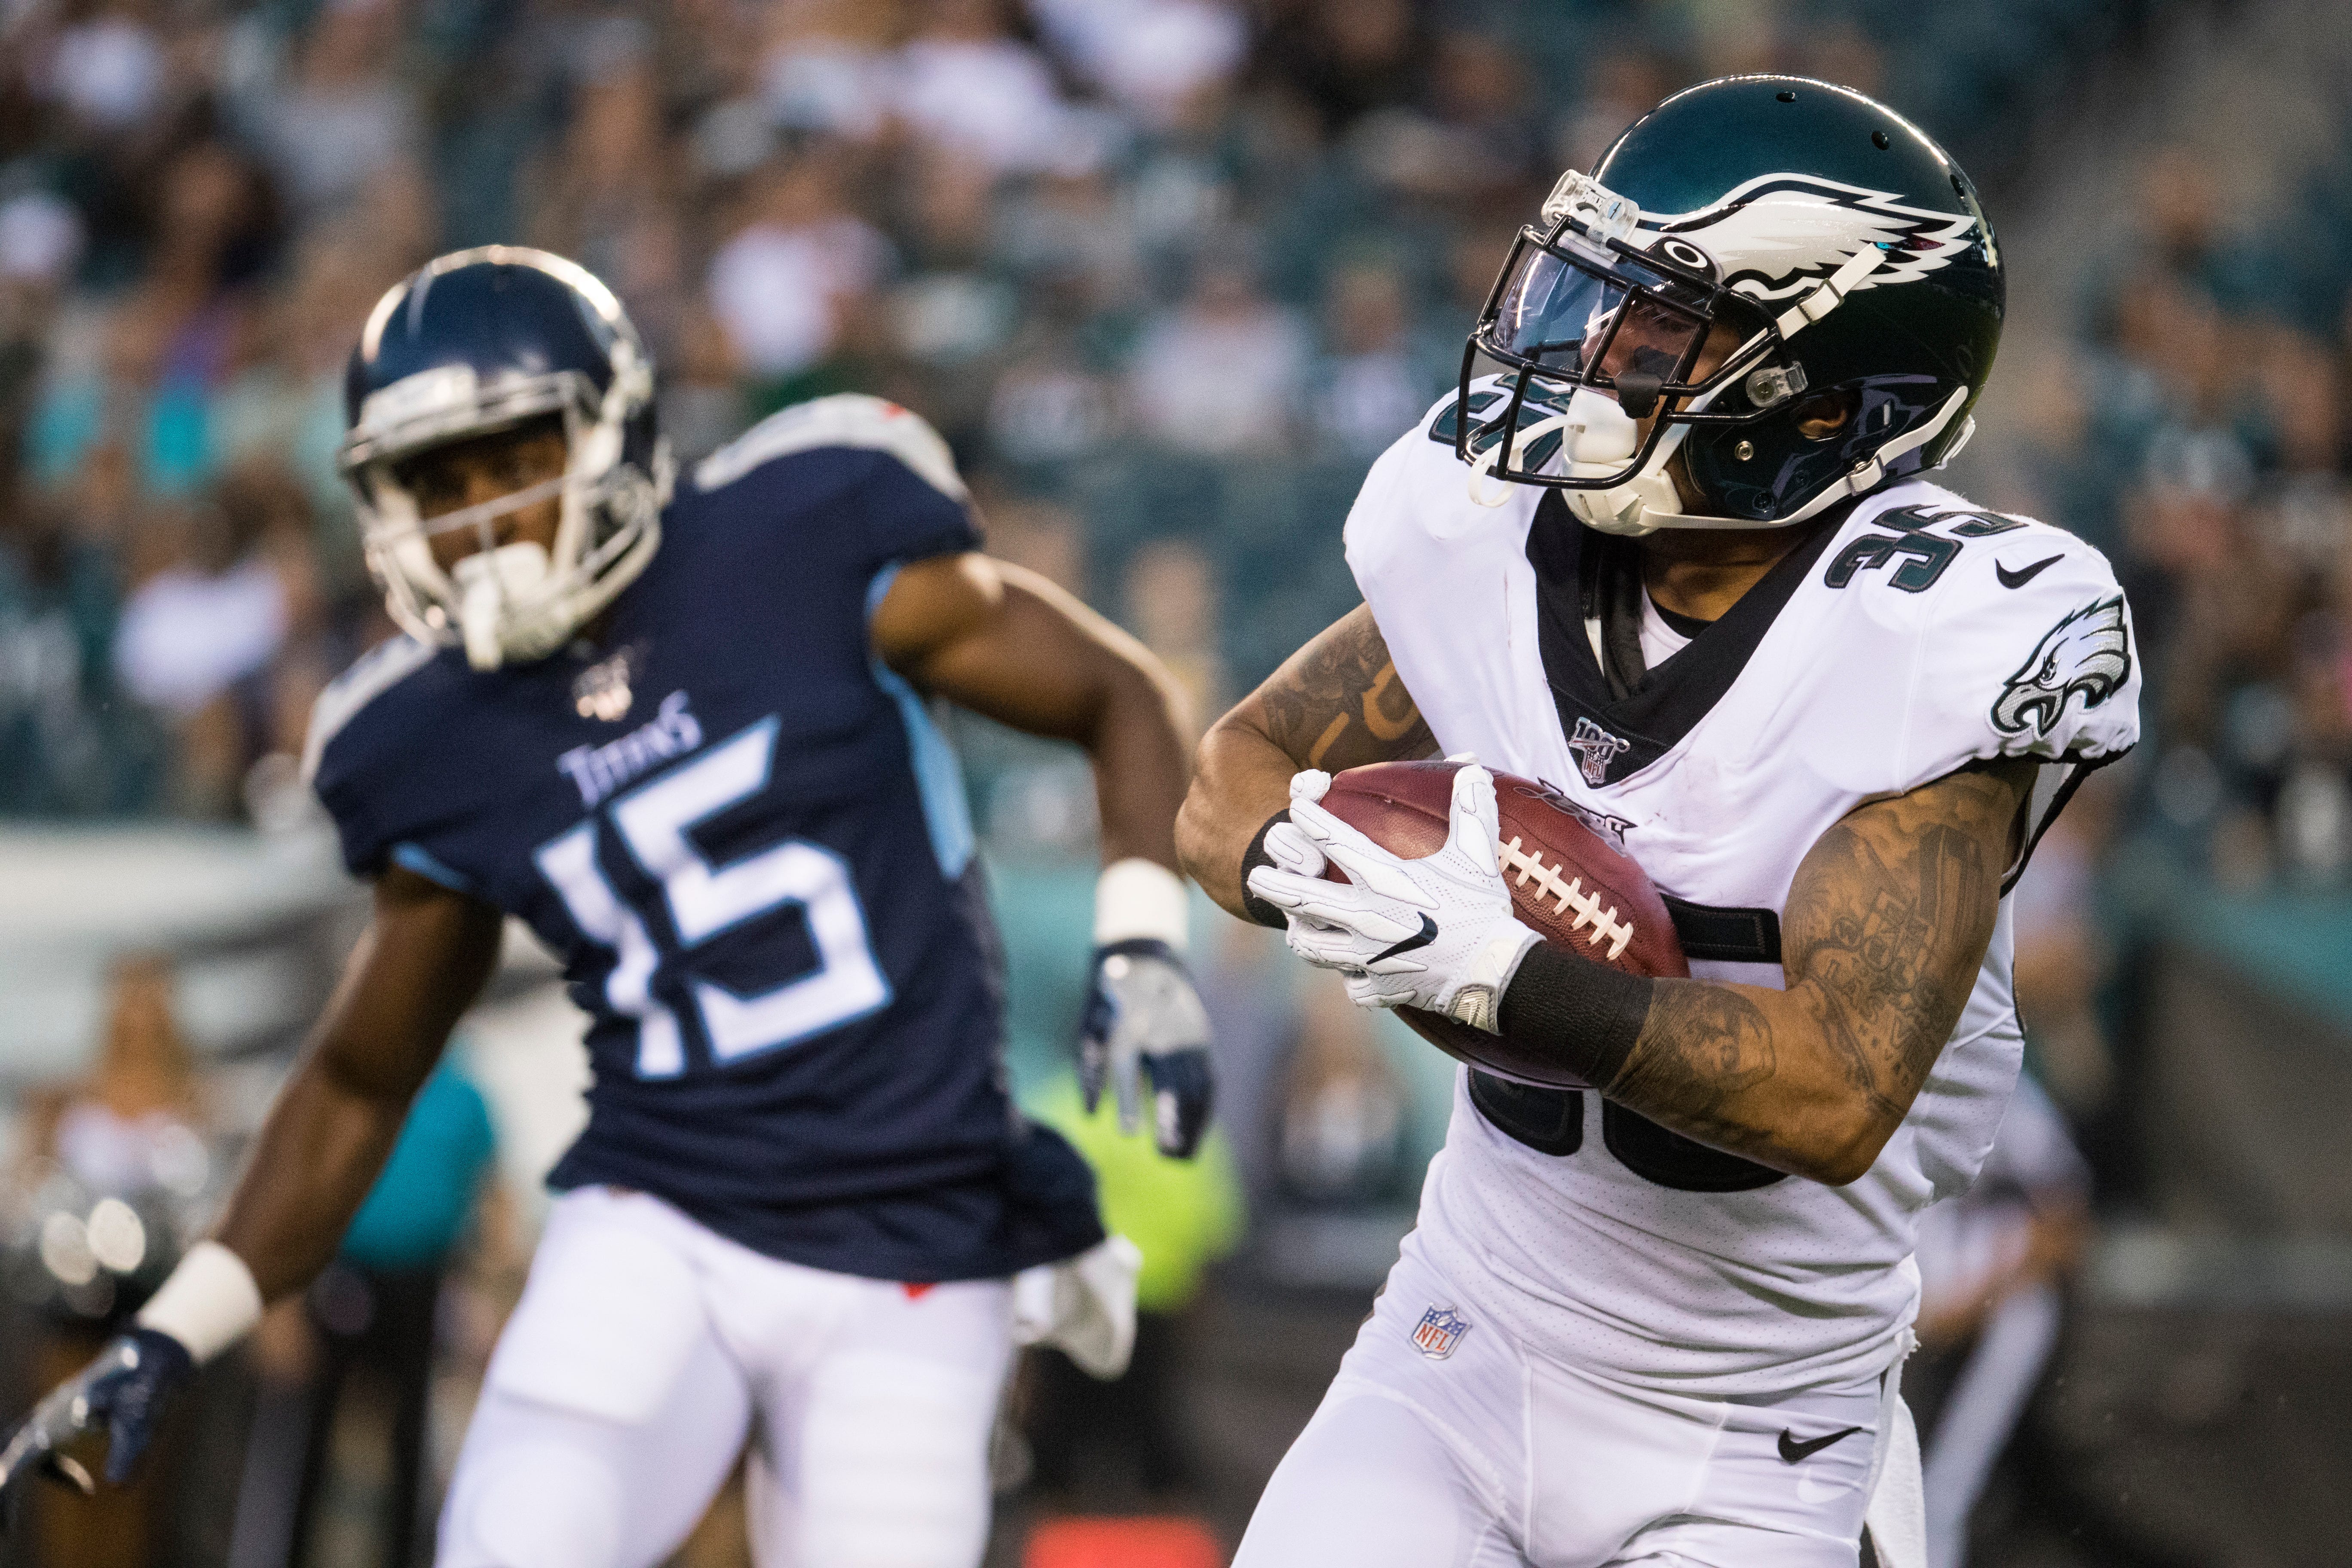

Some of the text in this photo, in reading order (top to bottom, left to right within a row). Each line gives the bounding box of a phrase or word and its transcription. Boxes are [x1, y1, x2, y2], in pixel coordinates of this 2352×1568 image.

[1824, 504, 2030, 594] 35
[1586, 760, 1602, 777] NFL
[534, 714, 893, 1079] 15
[1416, 1324, 1449, 1351] NFL
